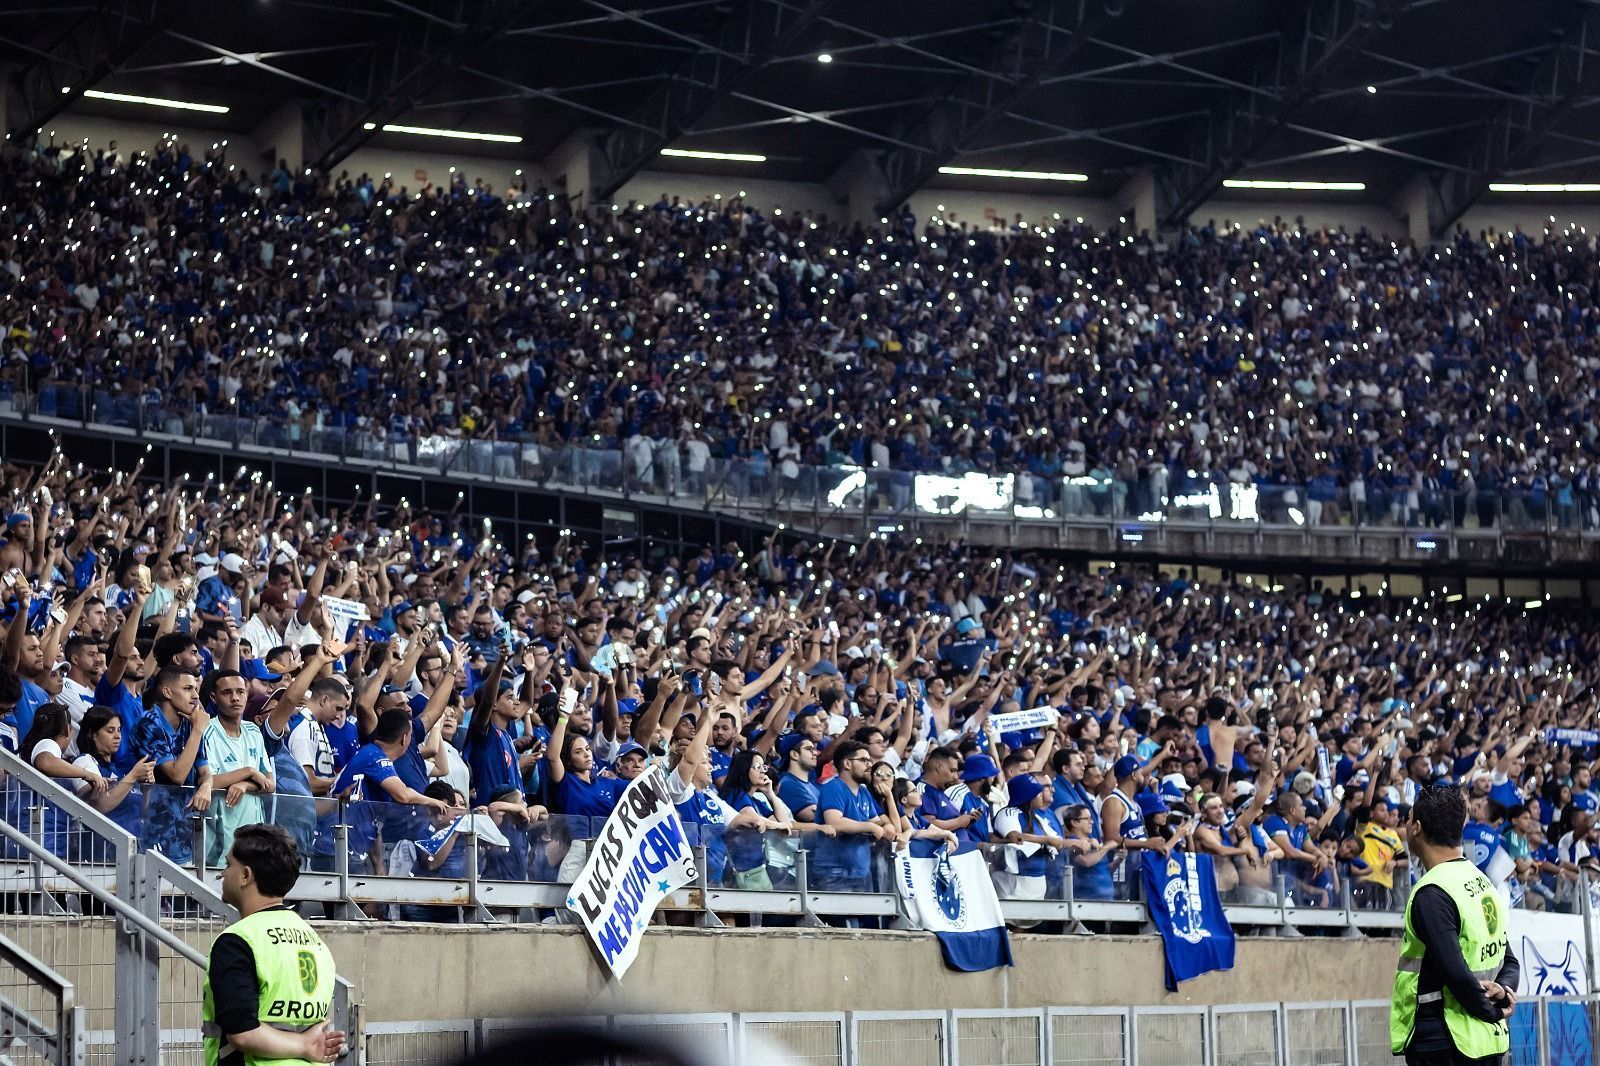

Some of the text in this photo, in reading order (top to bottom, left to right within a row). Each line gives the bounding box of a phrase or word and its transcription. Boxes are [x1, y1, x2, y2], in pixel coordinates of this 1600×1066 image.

[578, 823, 624, 925] LUCAS
[598, 913, 628, 966] ME
[622, 855, 651, 917] SUA
